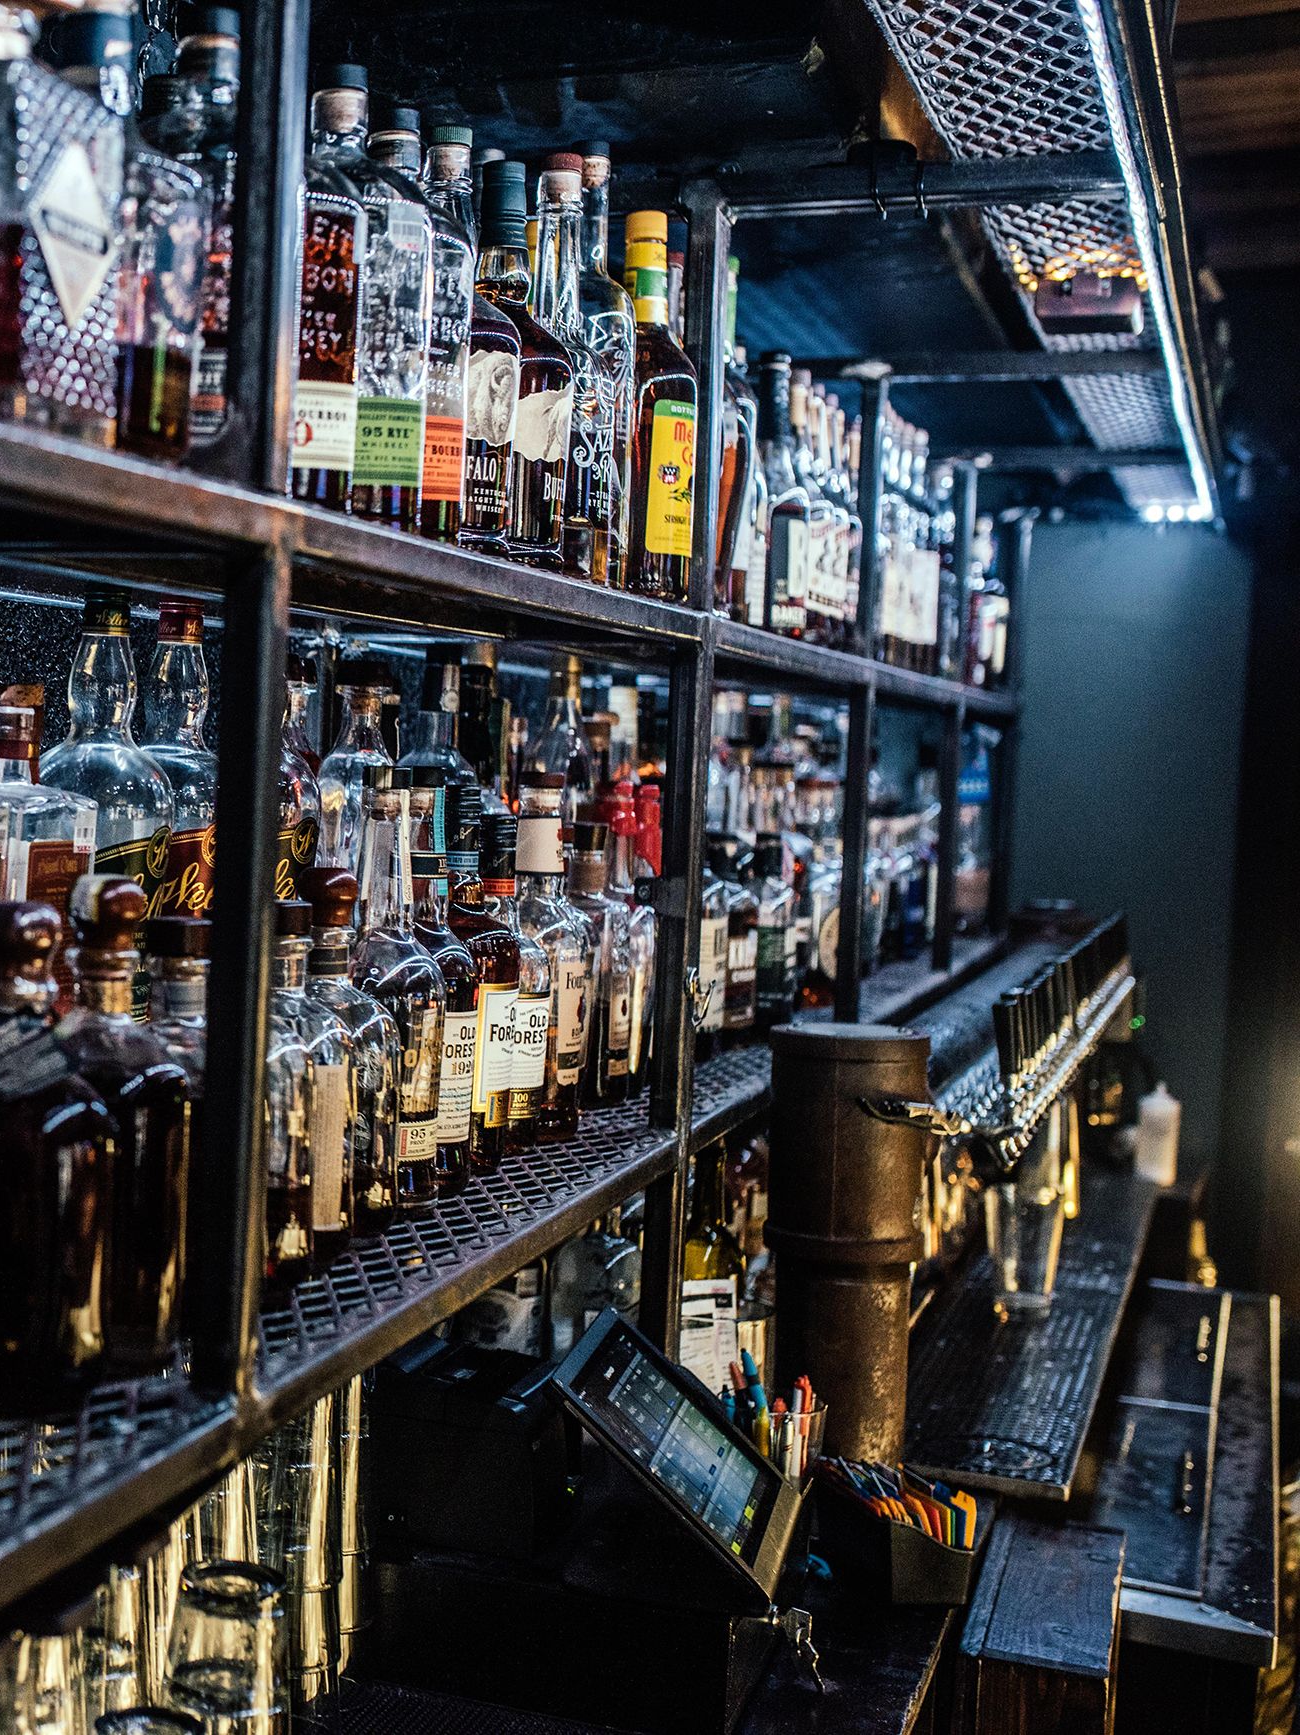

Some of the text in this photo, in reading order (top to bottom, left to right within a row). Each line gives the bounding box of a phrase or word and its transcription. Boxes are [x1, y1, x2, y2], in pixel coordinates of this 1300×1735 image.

[362, 426, 383, 438] 95
[387, 427, 410, 439] RYE
[529, 1014, 547, 1028] OLD
[513, 1093, 528, 1102] 100
[410, 1128, 426, 1139] 95
